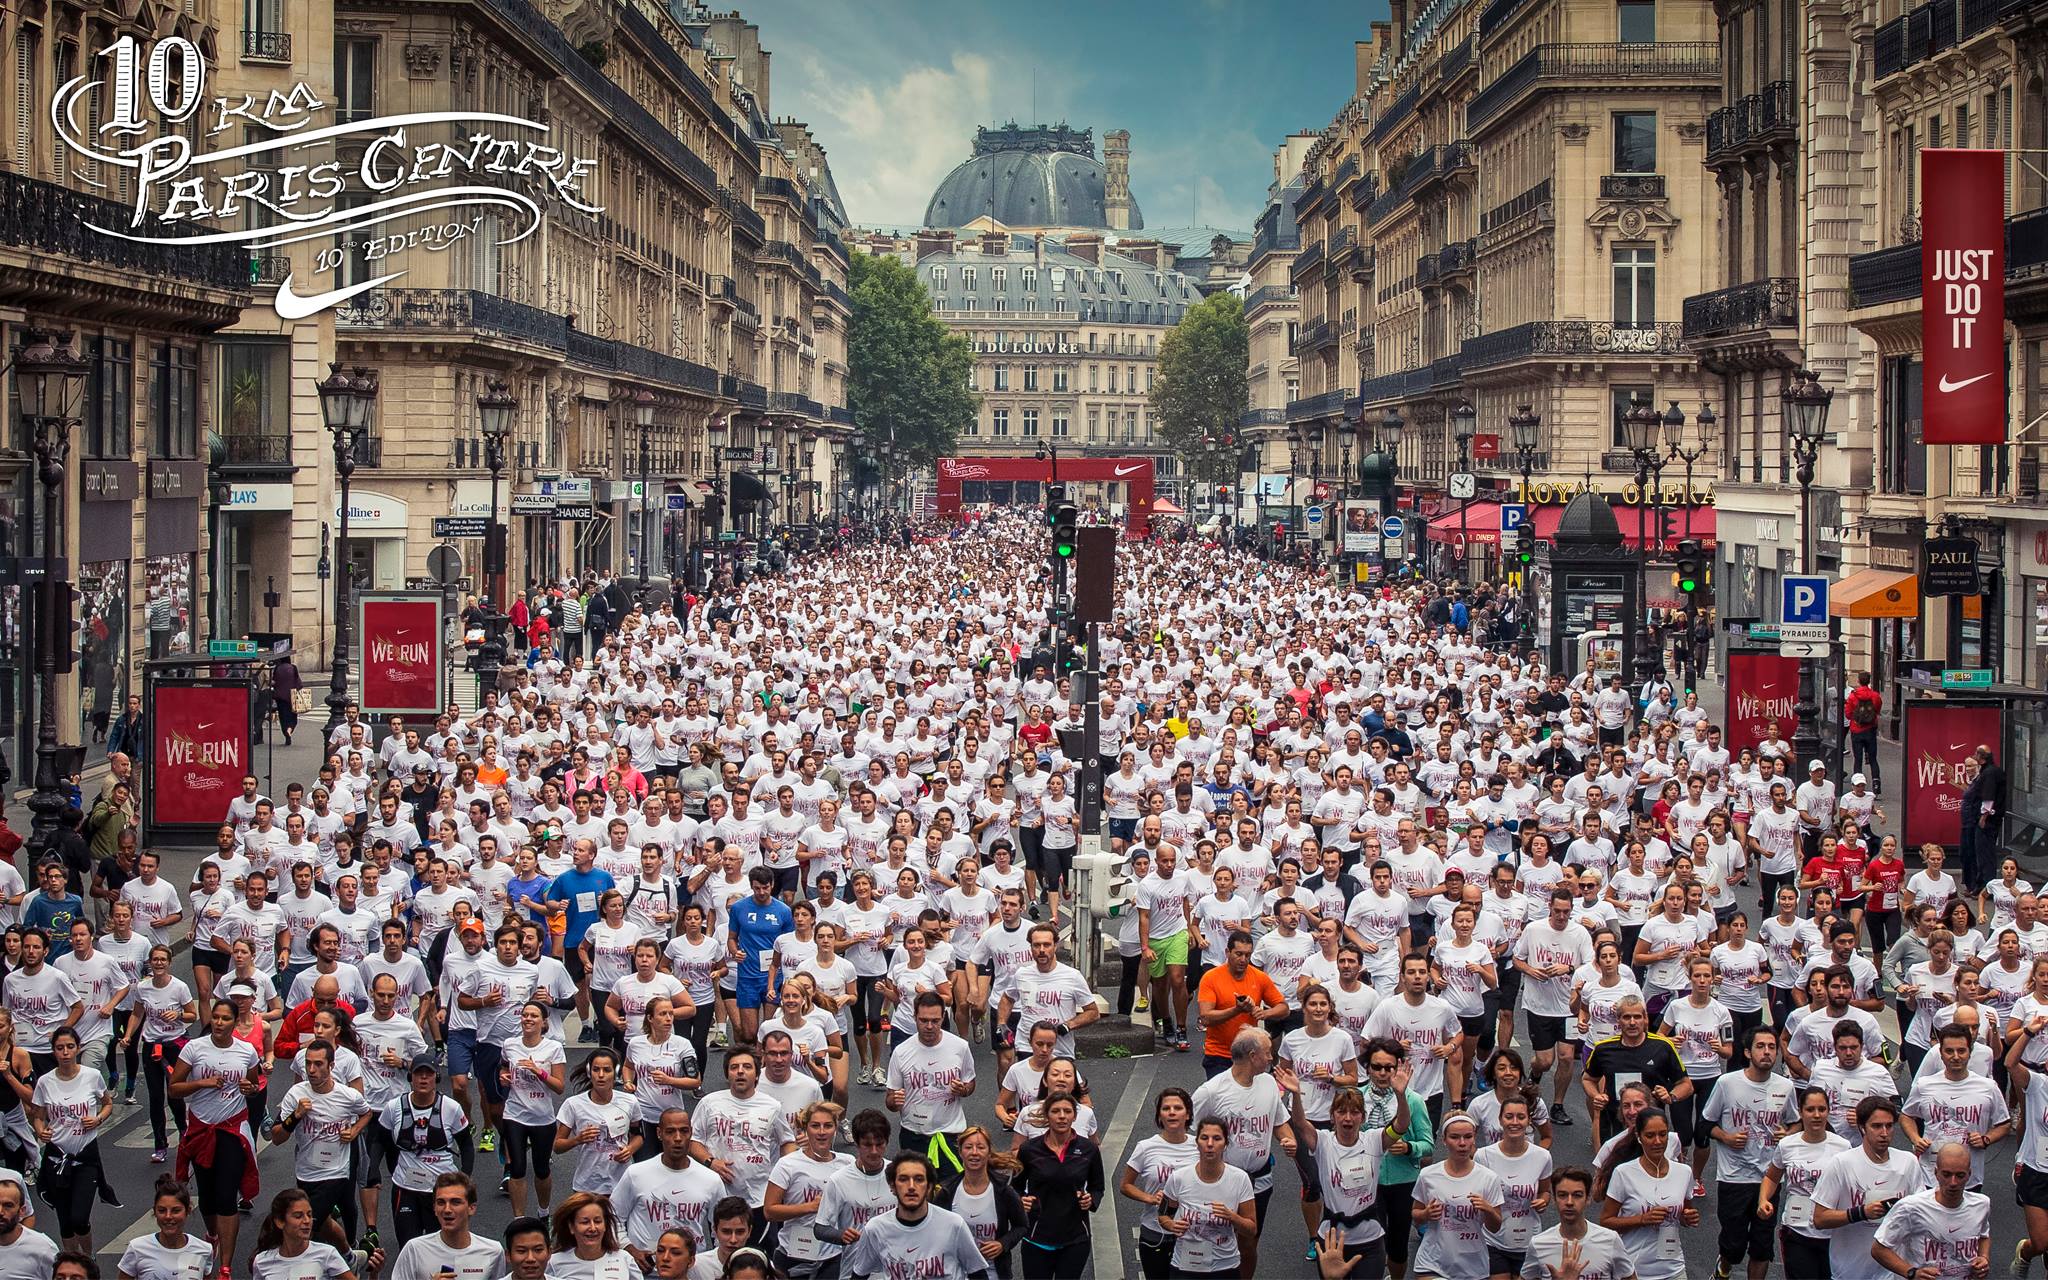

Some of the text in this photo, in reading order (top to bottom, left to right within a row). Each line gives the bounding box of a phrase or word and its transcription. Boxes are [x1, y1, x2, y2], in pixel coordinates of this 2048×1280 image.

[1932, 249, 1994, 281] JUST
[1945, 283, 1982, 315] DO
[1952, 317, 1976, 349] IT
[987, 342, 1007, 353] DU
[1012, 342, 1079, 354] LOUVRE
[946, 460, 956, 468] 10
[231, 491, 257, 504] CLAYS
[1316, 484, 1328, 497] illy
[1622, 481, 1717, 505] OPERA
[1508, 511, 1521, 526] P
[1475, 533, 1496, 541] DINER
[1930, 552, 1972, 564] PAUL
[1794, 585, 1816, 616] P
[1781, 629, 1828, 639] PYRAMIDES
[371, 640, 429, 665] WE RUN
[1737, 695, 1794, 720] WE RUN
[165, 736, 239, 768] WE RUN
[1917, 758, 1946, 788] WE
[603, 861, 636, 873] WE RUN
[1250, 865, 1265, 877] RUN
[1408, 869, 1425, 882] RUN
[145, 901, 162, 913] RUN
[637, 898, 649, 910] WE
[1370, 915, 1384, 928] WE
[240, 923, 255, 938] WE
[994, 951, 1010, 967] WE
[1535, 947, 1574, 965] WE RUN
[27, 995, 47, 1012] RUN
[1039, 990, 1061, 1007] RUN
[1591, 1006, 1604, 1018] WE
[1391, 1027, 1438, 1045] WE RUN
[222, 1069, 243, 1082] RUN
[909, 1070, 928, 1089] WE
[50, 1101, 89, 1118] WE RUN
[1732, 1108, 1781, 1127] WE RUN
[1929, 1103, 1983, 1126] WE RUN
[303, 1121, 342, 1134] WE RUN
[716, 1117, 735, 1137] WE
[1226, 1114, 1271, 1134] WE RUN
[746, 1155, 764, 1164] 9280
[1789, 1169, 1804, 1185] WE
[1511, 1183, 1536, 1200] RUN
[646, 1200, 706, 1222] WE RUN
[851, 1206, 870, 1225] WE
[1184, 1207, 1201, 1226] WE
[1456, 1204, 1478, 1220] RUN
[975, 1222, 998, 1238] RUN
[1923, 1235, 1980, 1262] WE RUN
[886, 1253, 946, 1280] WE RUN
